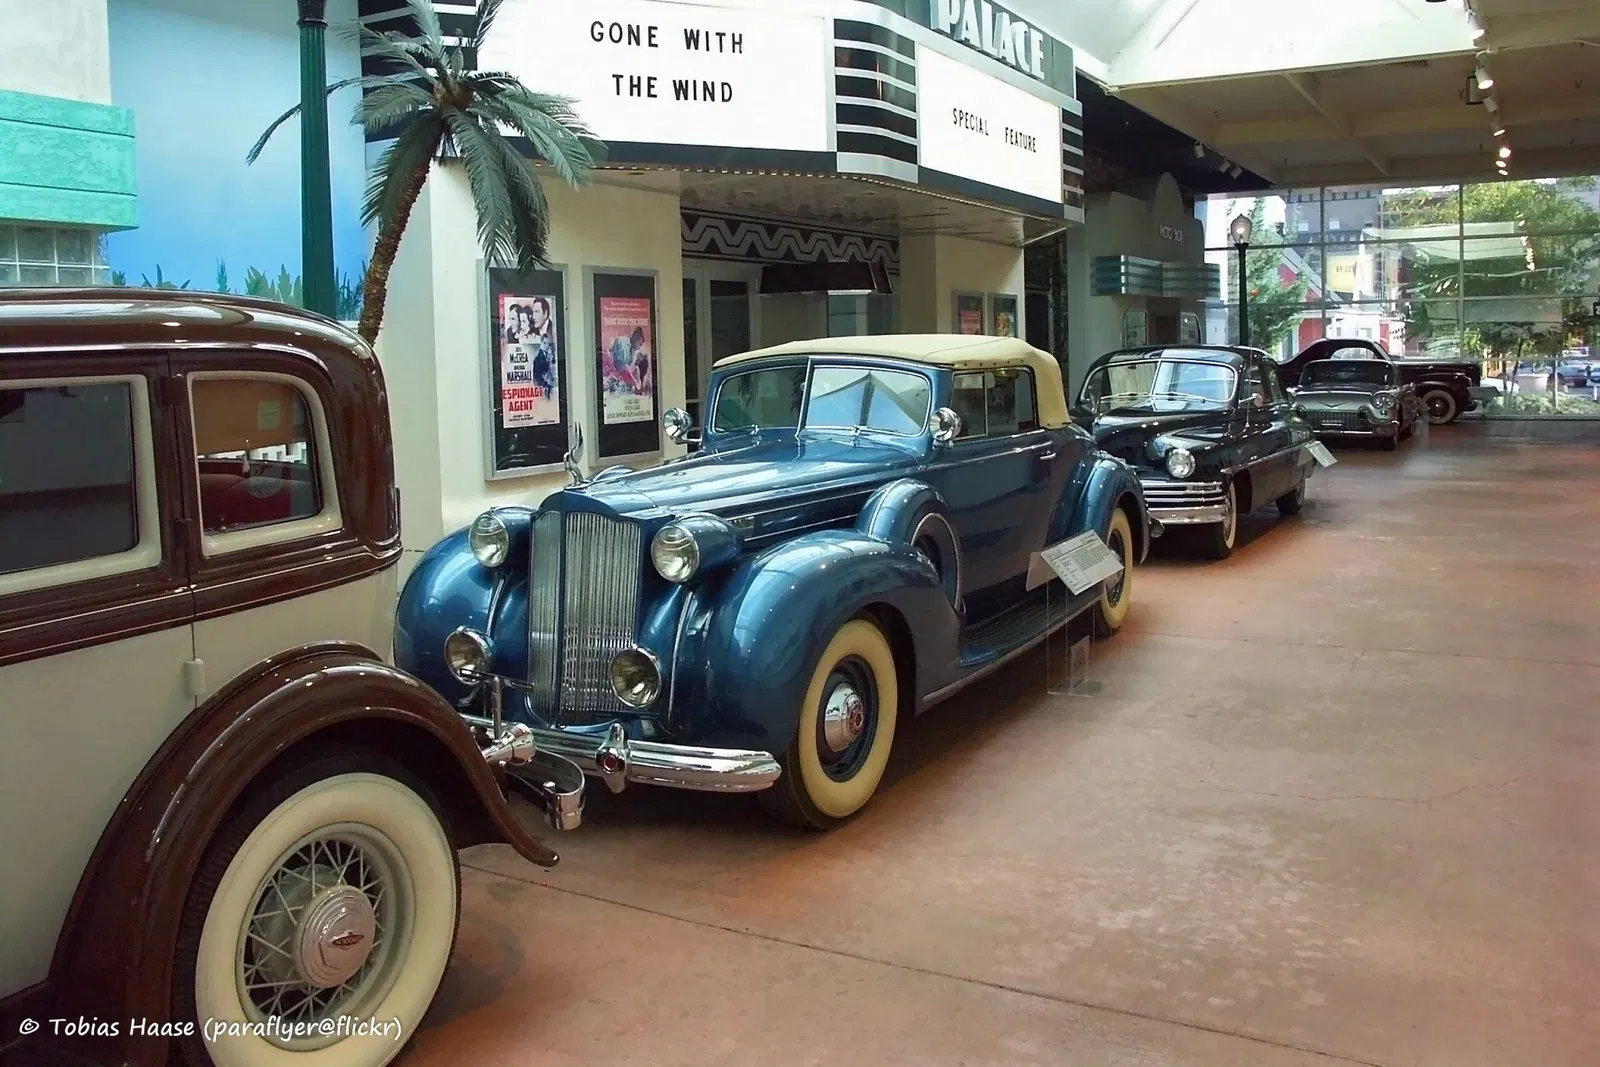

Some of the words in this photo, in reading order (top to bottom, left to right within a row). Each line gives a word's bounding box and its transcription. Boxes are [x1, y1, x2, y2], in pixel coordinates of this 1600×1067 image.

[590, 20, 659, 48] GONE
[684, 28, 743, 54] WITH
[930, 0, 1045, 80] PALACE
[612, 74, 658, 98] THE
[672, 79, 733, 103] WIND
[952, 107, 989, 137] SPECIAL
[1004, 126, 1037, 153] FEATURE
[506, 370, 532, 381] MARSHALL
[502, 387, 544, 400] ESPIONAGE
[508, 400, 534, 412] AGENT
